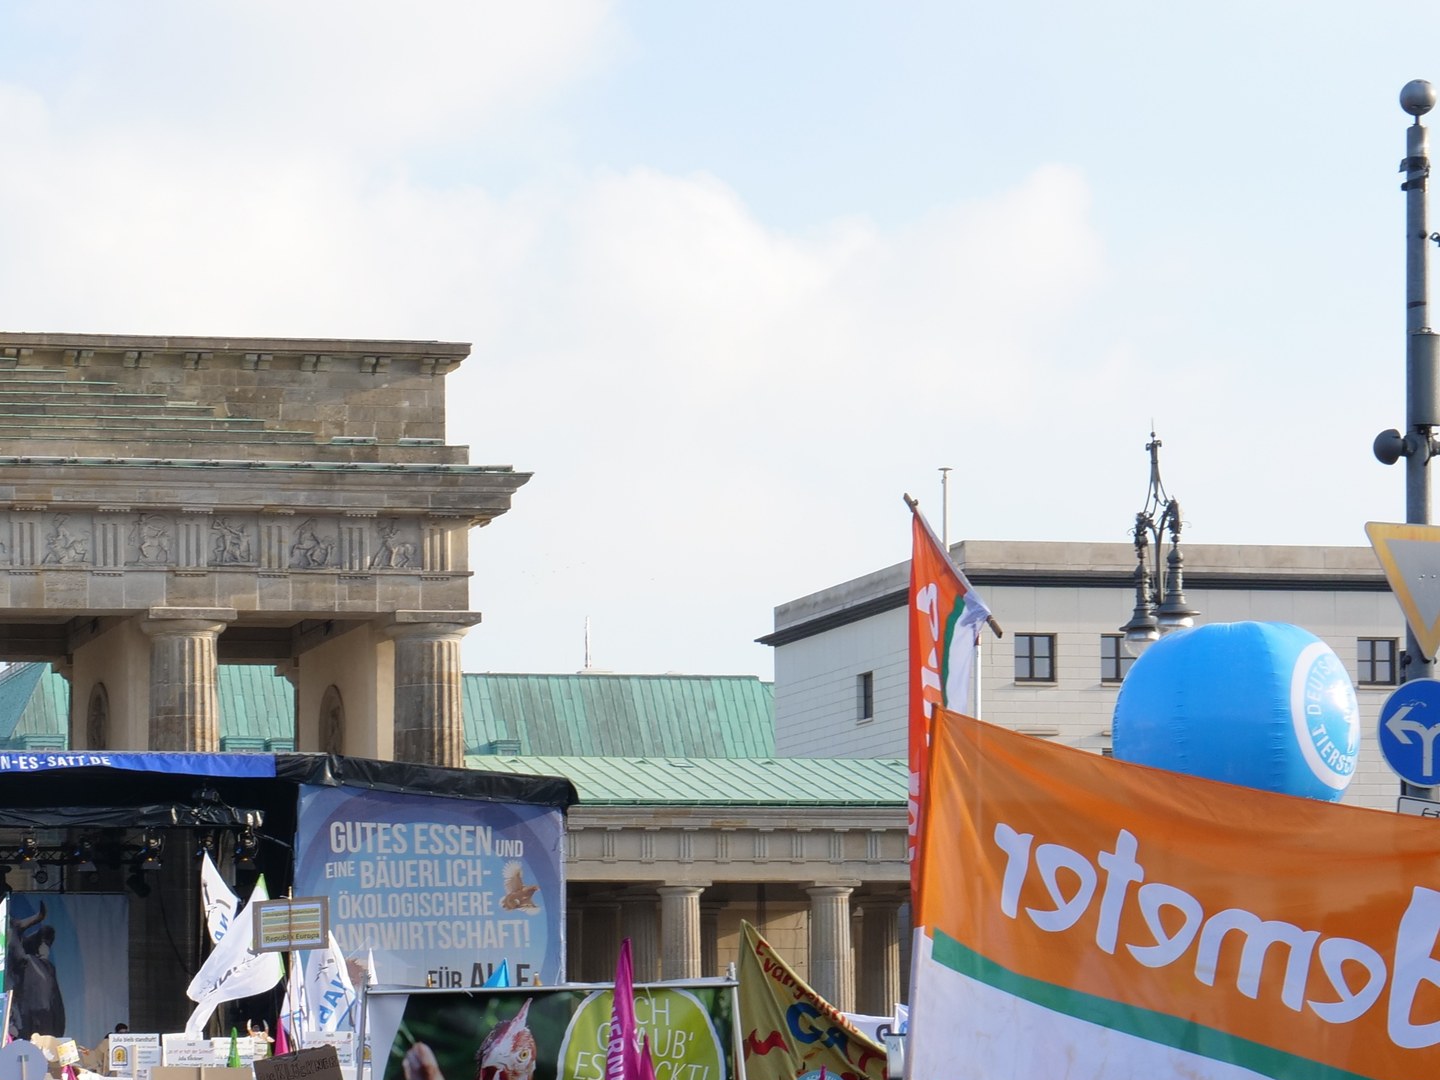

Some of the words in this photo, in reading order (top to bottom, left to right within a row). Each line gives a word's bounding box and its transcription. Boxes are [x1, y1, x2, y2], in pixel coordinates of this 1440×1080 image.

[329, 821, 408, 855] GUTES
[414, 824, 493, 857] ESSEN
[494, 839, 523, 858] UND
[325, 861, 355, 879] EINE
[360, 856, 492, 889] BÄUERLICH-
[337, 891, 495, 920] ÖKOLOGISCHERE
[332, 919, 531, 951] ANDWIRTSCHAFT!
